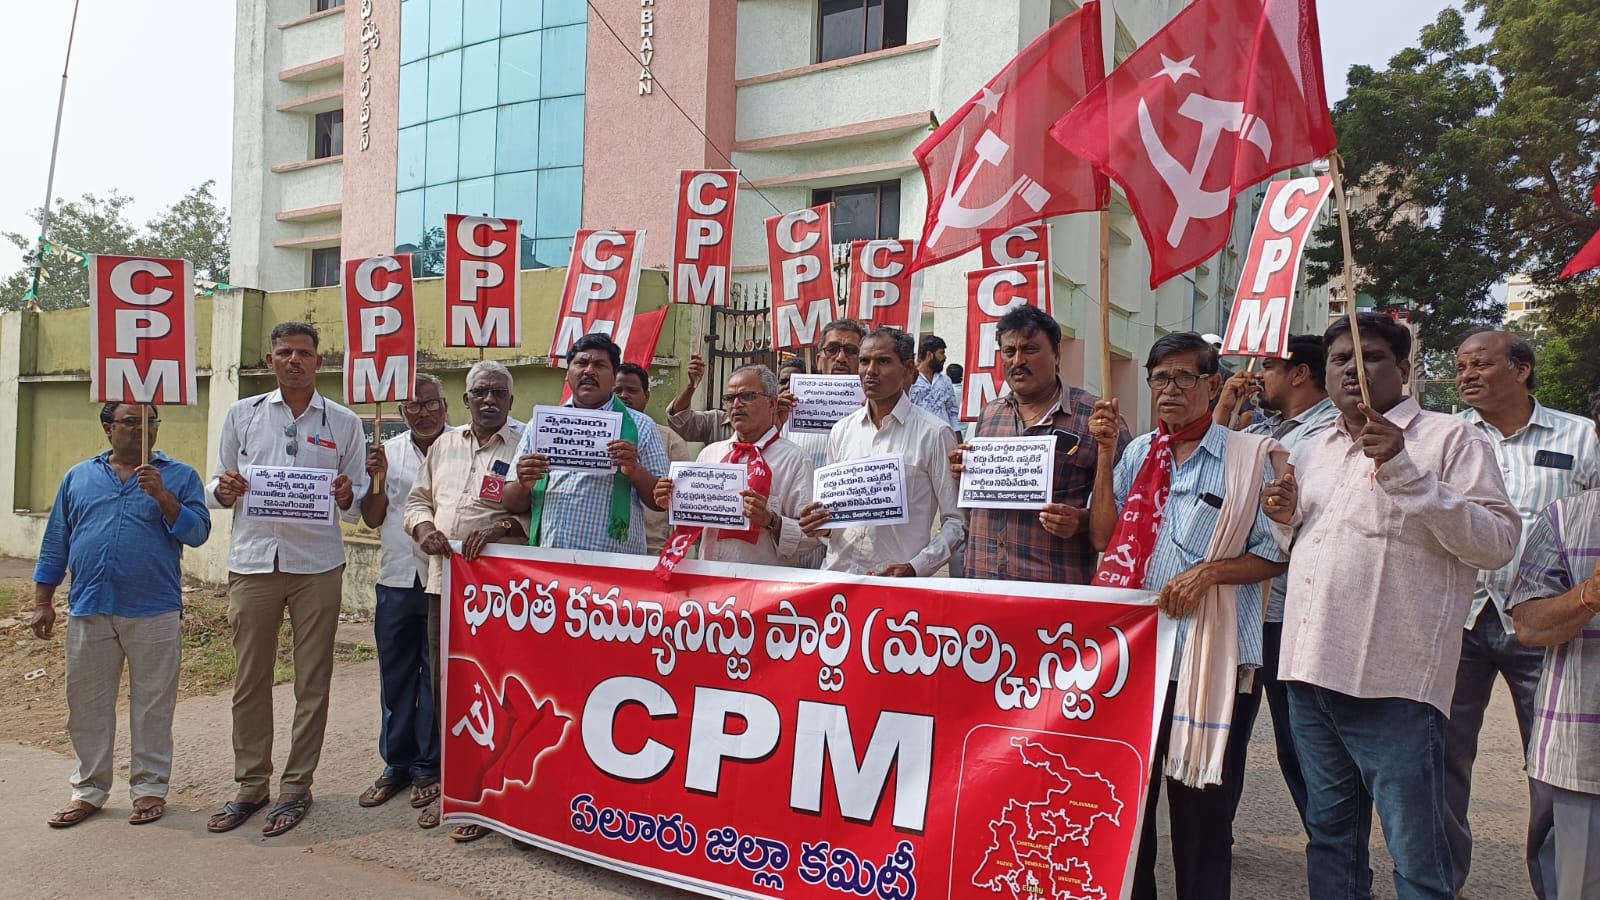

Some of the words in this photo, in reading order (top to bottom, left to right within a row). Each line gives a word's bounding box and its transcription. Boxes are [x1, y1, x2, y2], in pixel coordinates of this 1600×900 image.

[639, 9, 654, 95] BHAVAN
[452, 216, 510, 346] CPM
[555, 230, 627, 357] CPM
[677, 173, 728, 305] CPM
[776, 209, 832, 348] CPM
[859, 239, 905, 329] CP
[1227, 176, 1319, 352] CPM
[105, 260, 180, 403] CPM
[353, 256, 402, 402] CPM
[463, 579, 559, 636] భారత
[564, 585, 755, 681] కమ్యూనిస్టు
[765, 593, 852, 692] పార్టీ
[861, 608, 1130, 721] (మార్క్సిస్టు)
[581, 675, 935, 832] CPM
[570, 794, 697, 855] ఏలూరు
[705, 826, 790, 889] జిల్లా
[798, 840, 916, 900] కమిటీ
